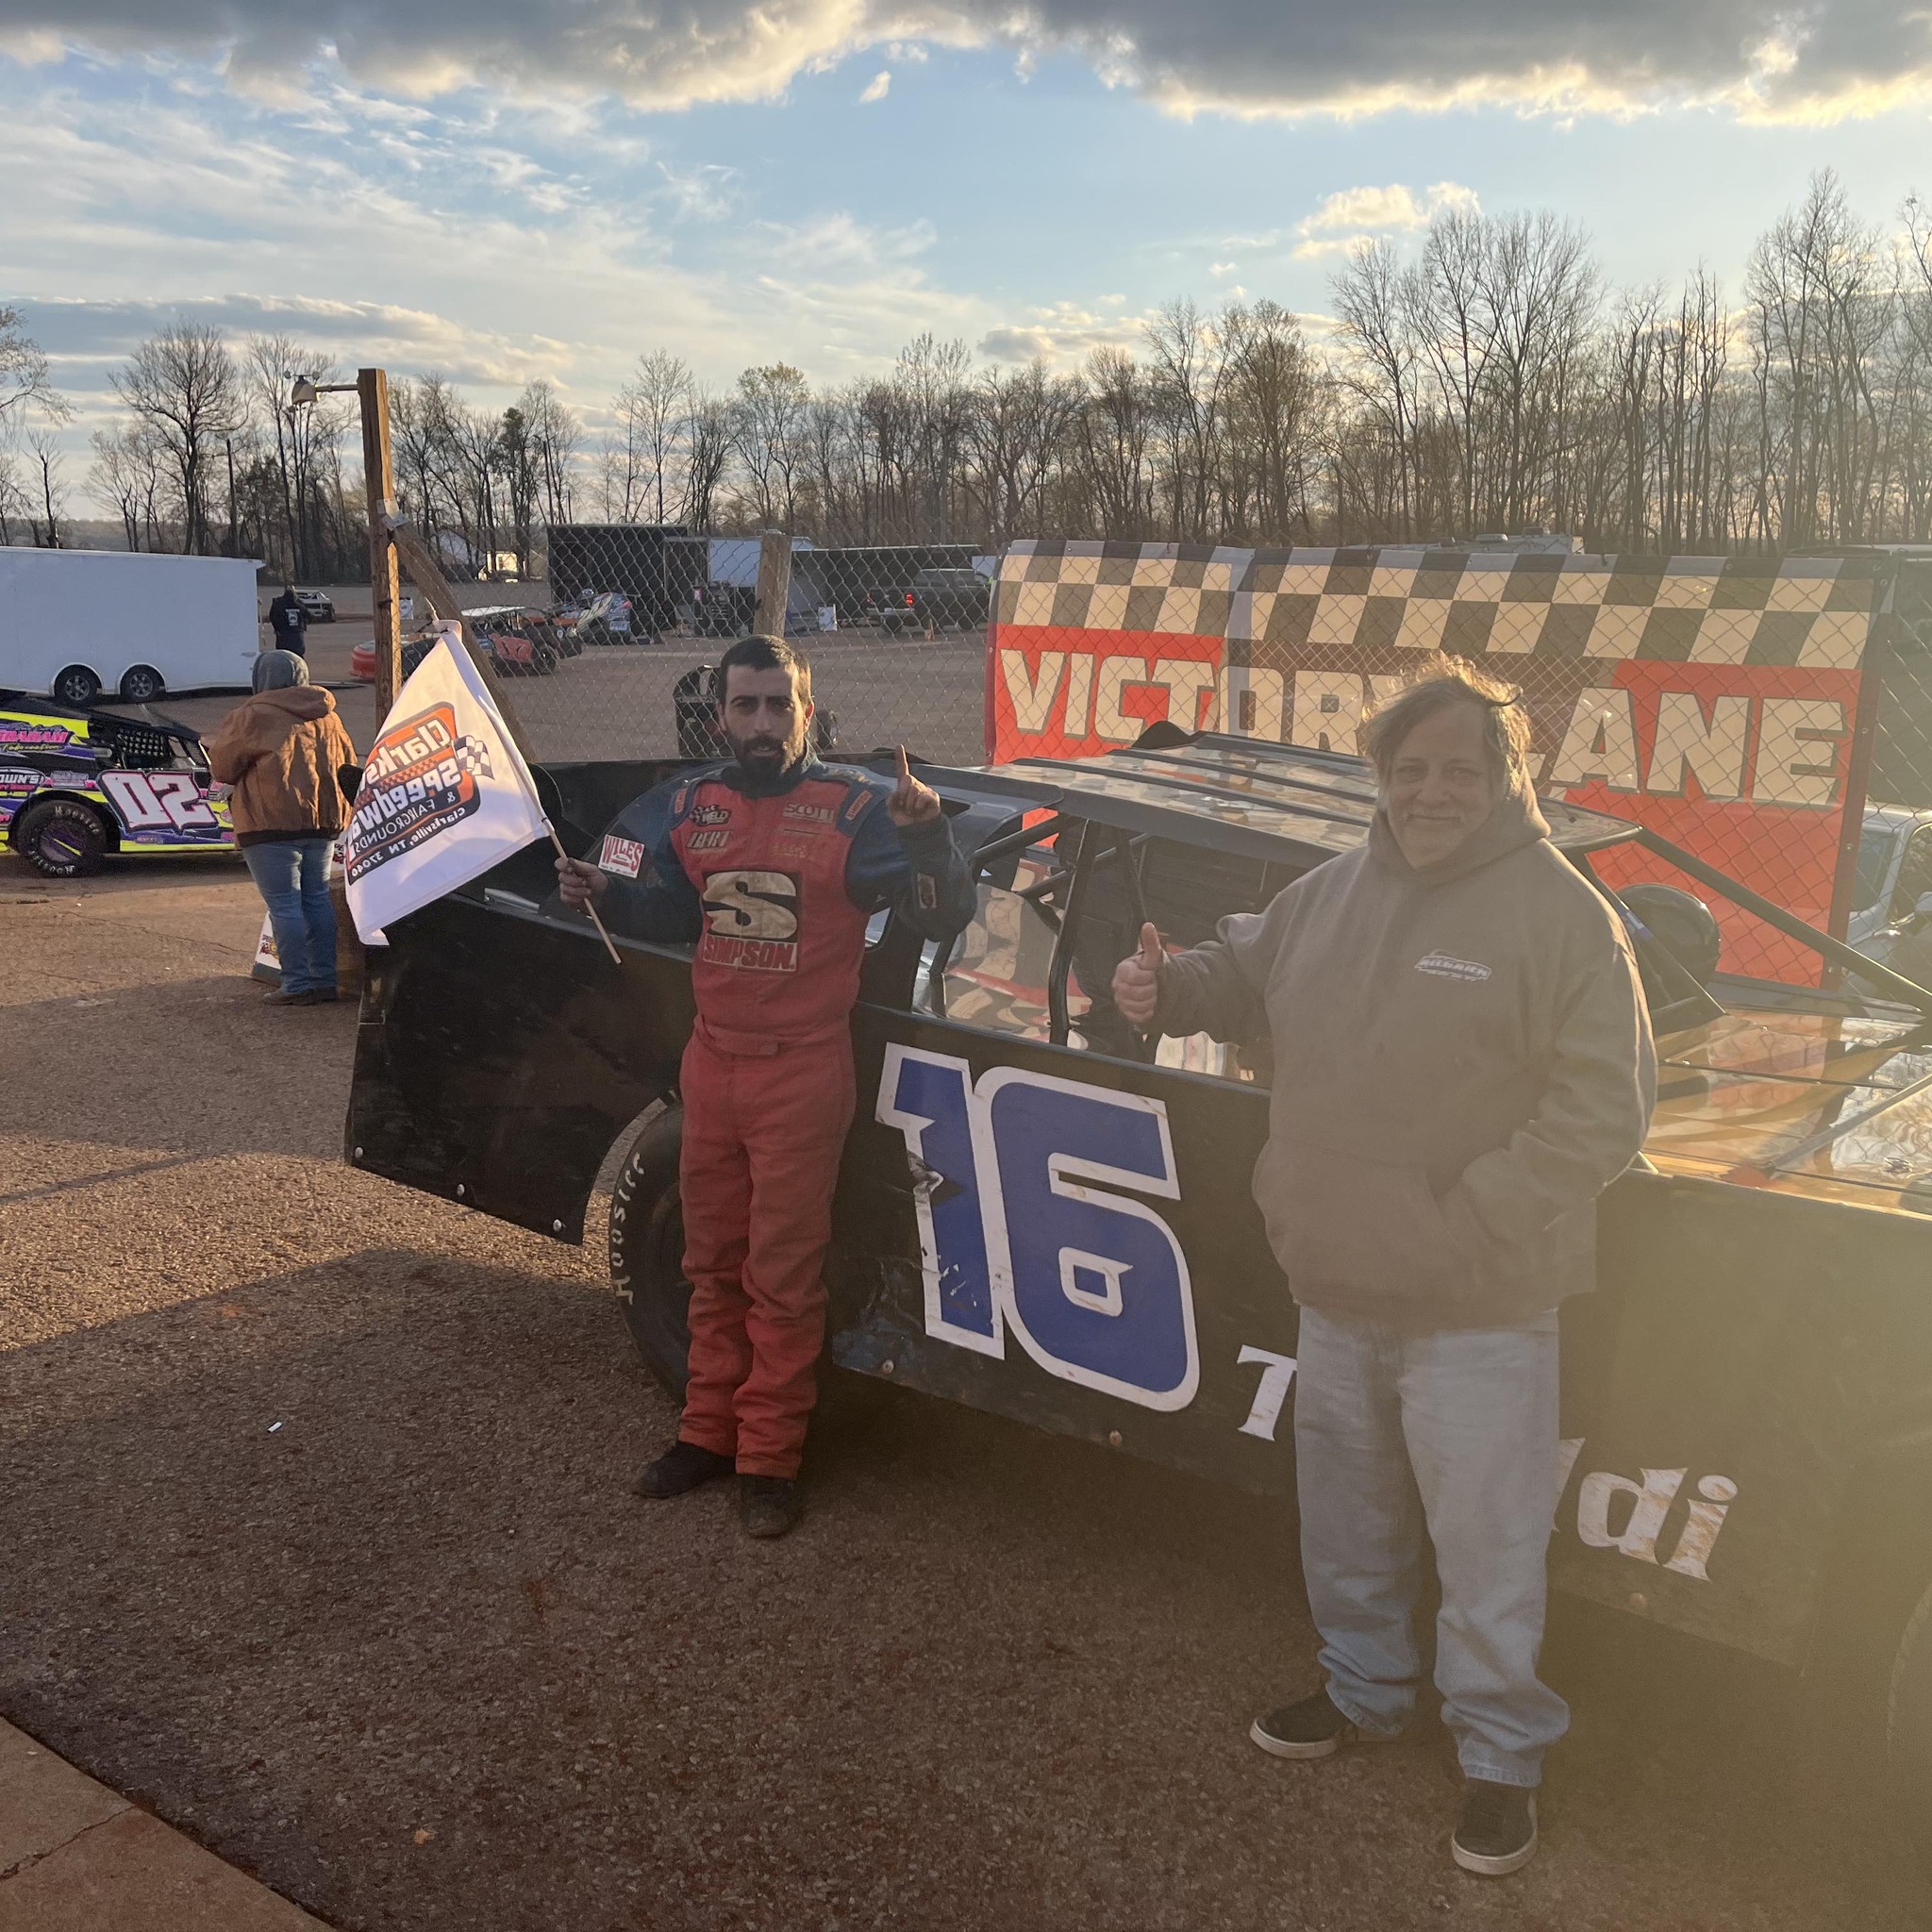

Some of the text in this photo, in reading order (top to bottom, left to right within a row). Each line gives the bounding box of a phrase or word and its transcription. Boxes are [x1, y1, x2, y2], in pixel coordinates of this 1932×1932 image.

[1000, 648, 1847, 808] VICTOR ANE
[700, 809, 731, 824] WELD
[602, 835, 643, 872] WILES
[686, 830, 733, 848] BERT
[702, 870, 798, 940] S
[702, 934, 798, 971] SIMPSON
[875, 1041, 1201, 1412] 16
